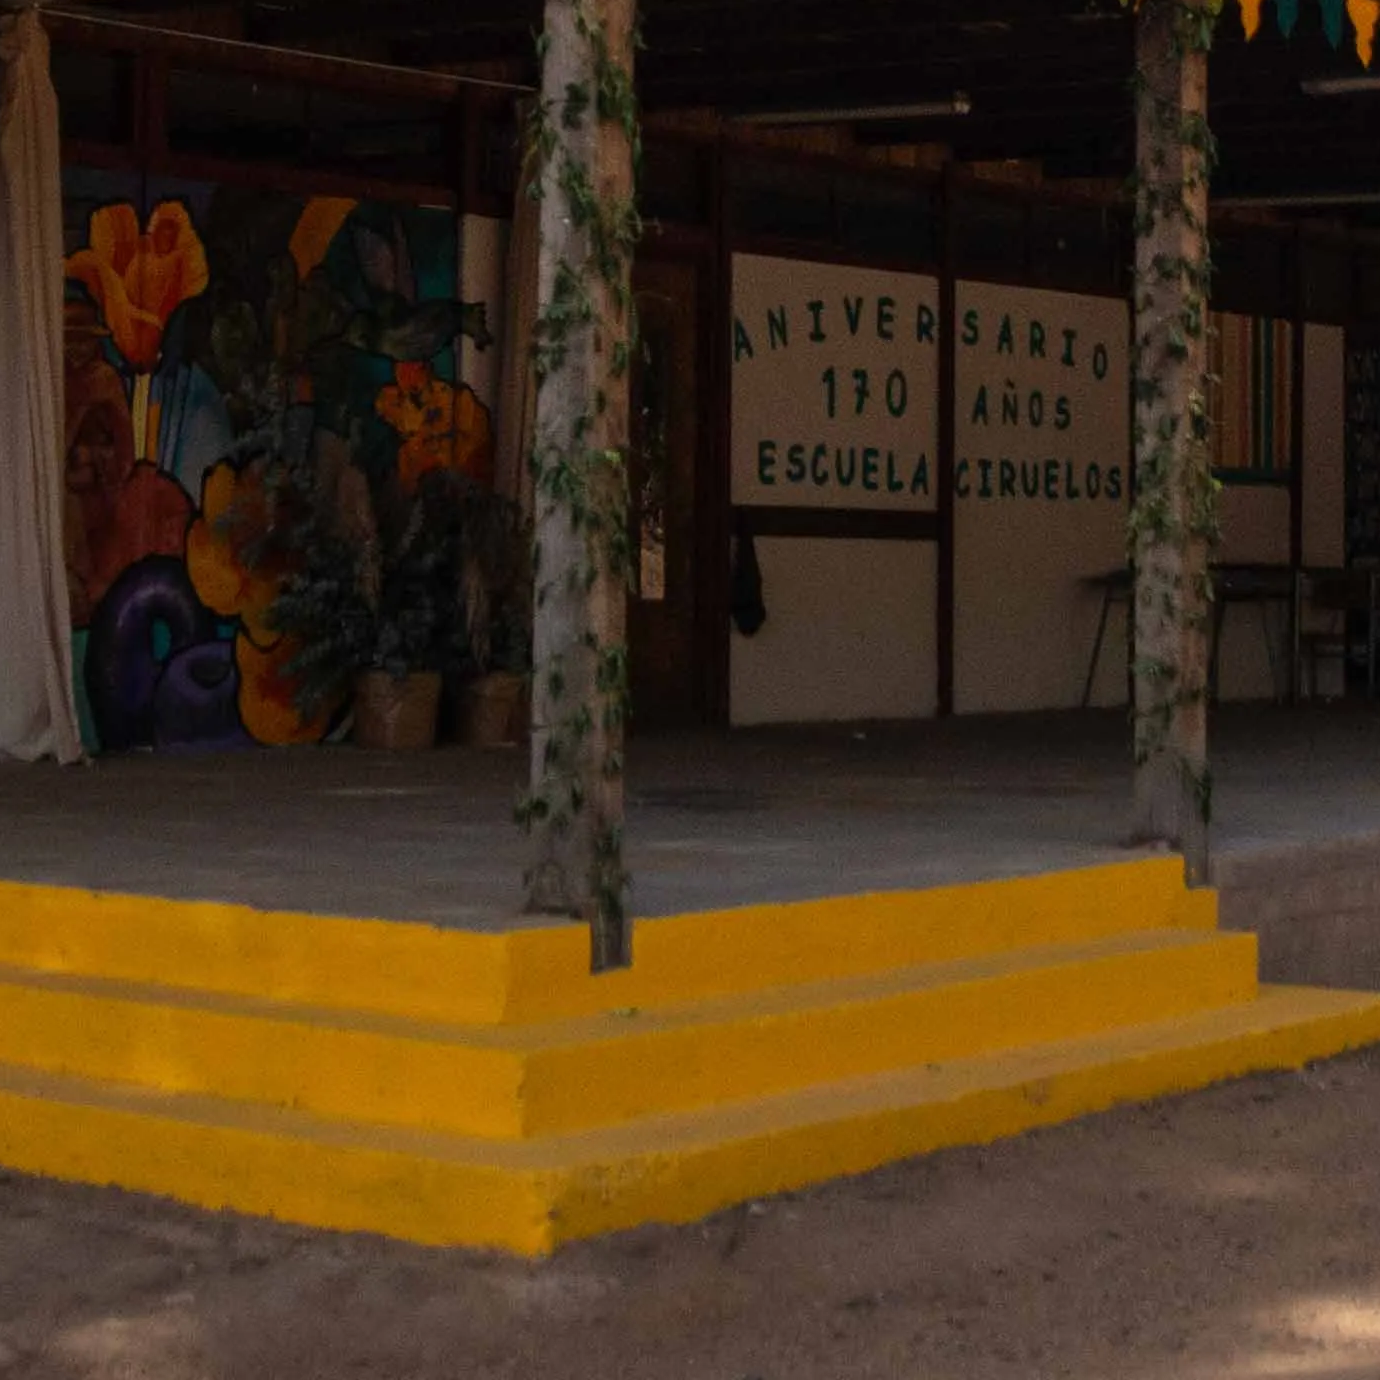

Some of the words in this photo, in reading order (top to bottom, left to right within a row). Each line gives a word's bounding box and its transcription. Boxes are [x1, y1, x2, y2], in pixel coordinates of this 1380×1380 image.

[733, 295, 1108, 381] ANIVERSARIO
[822, 366, 908, 419] 170
[971, 378, 1071, 431] AÑOS
[757, 440, 930, 497] ESCUELA
[952, 459, 1123, 500] CIRUELOS
